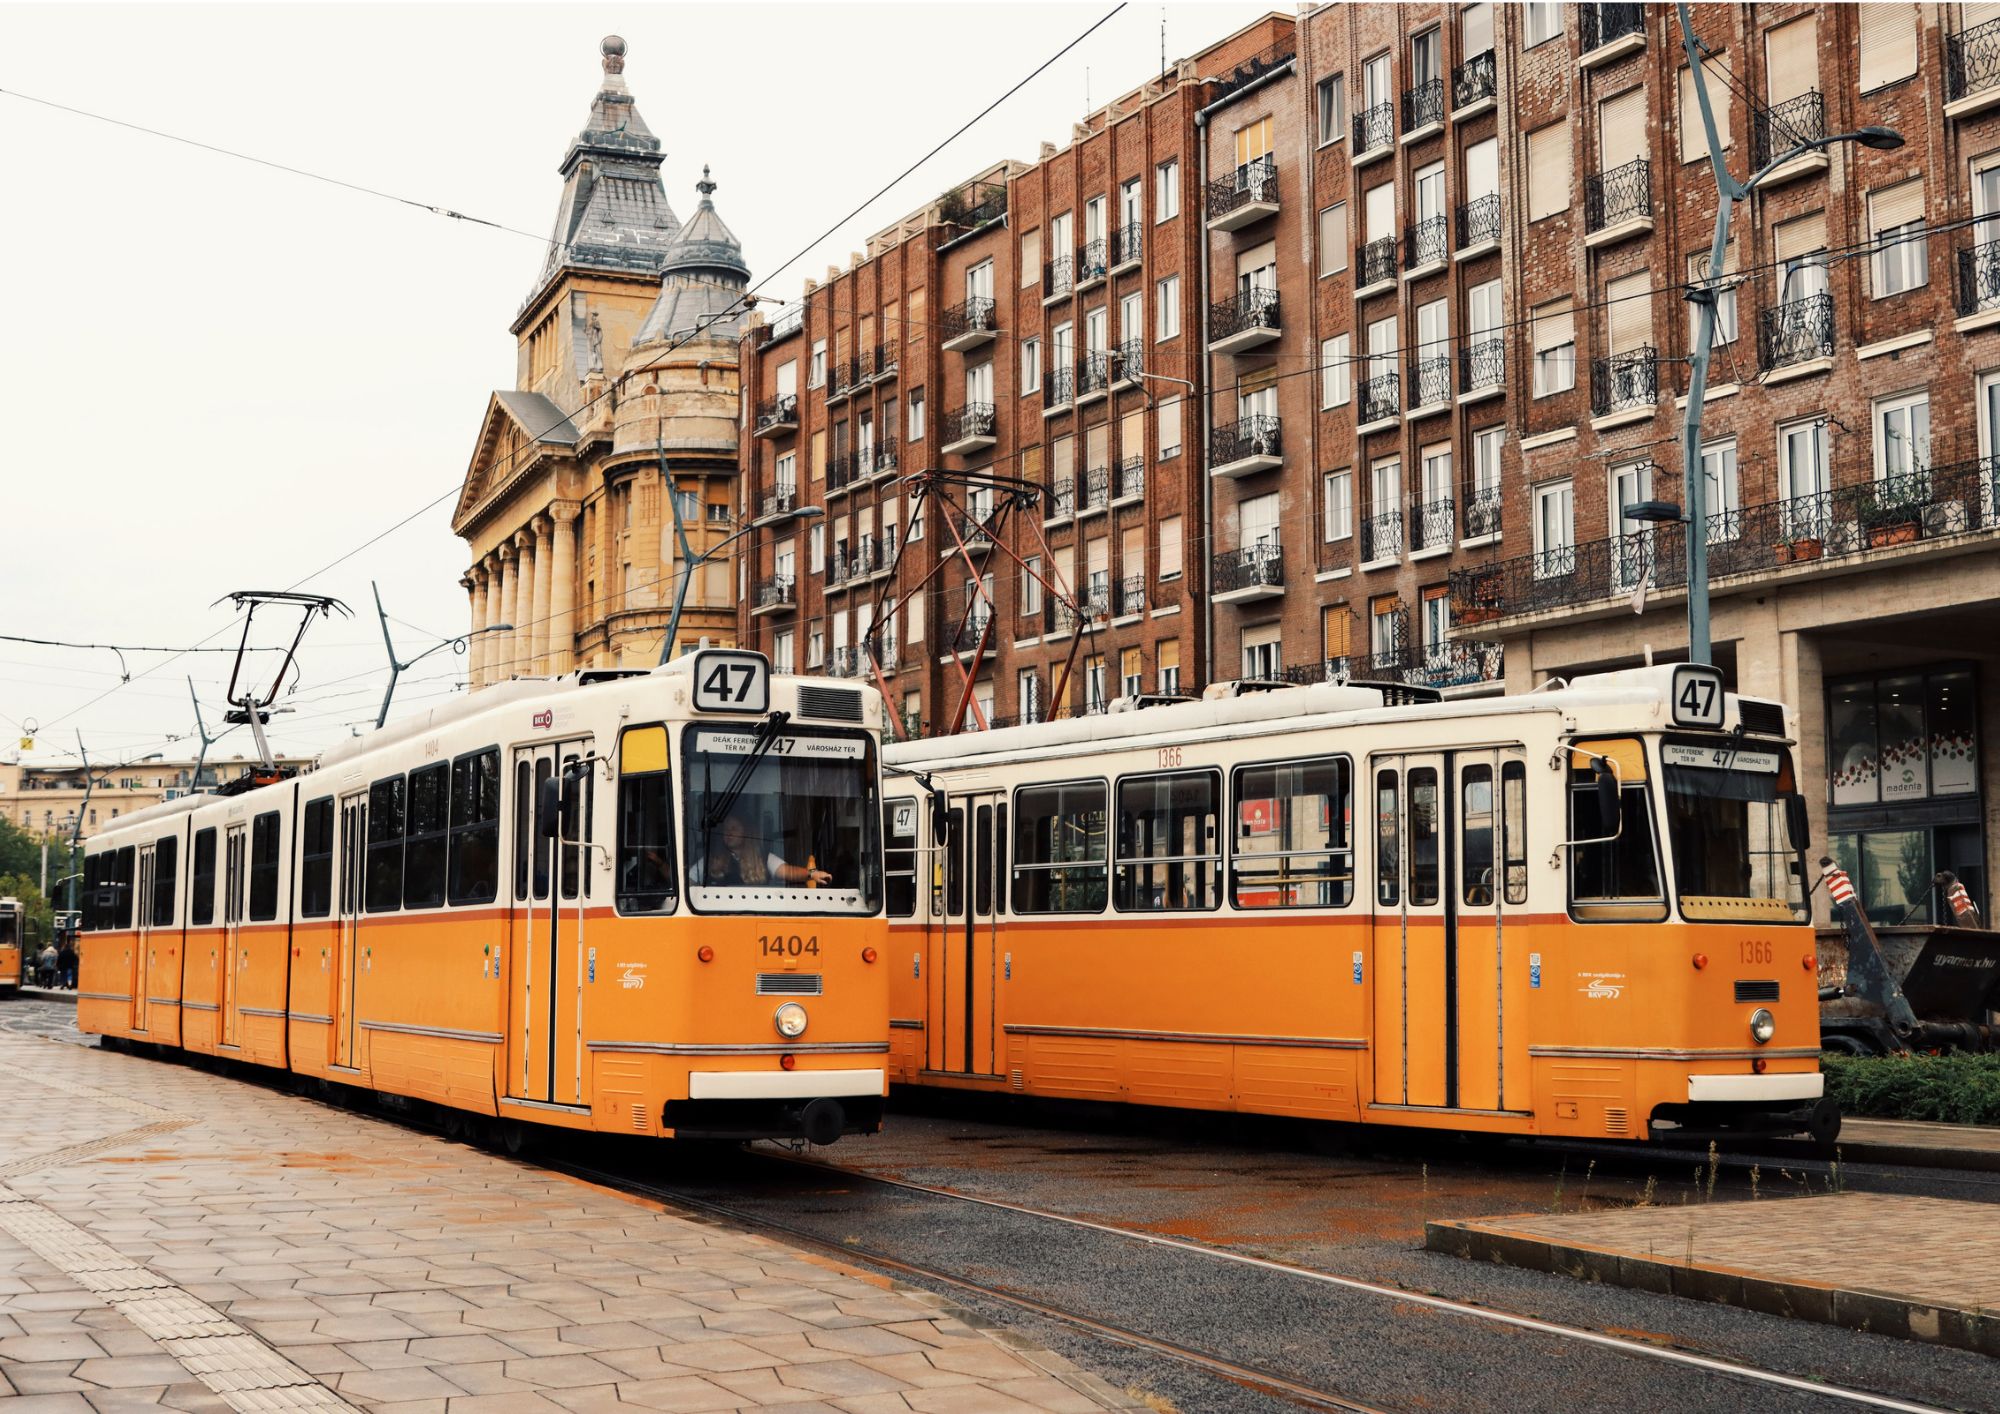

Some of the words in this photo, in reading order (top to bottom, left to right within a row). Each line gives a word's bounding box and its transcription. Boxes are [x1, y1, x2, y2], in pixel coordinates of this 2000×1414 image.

[703, 663, 756, 702] 47
[1680, 679, 1716, 717] 47
[772, 738, 796, 754] 47
[1158, 747, 1182, 769] 1366
[1712, 750, 1731, 766] 47
[897, 808, 911, 826] 47
[758, 935, 820, 957] 1404
[1740, 941, 1772, 965] 1366
